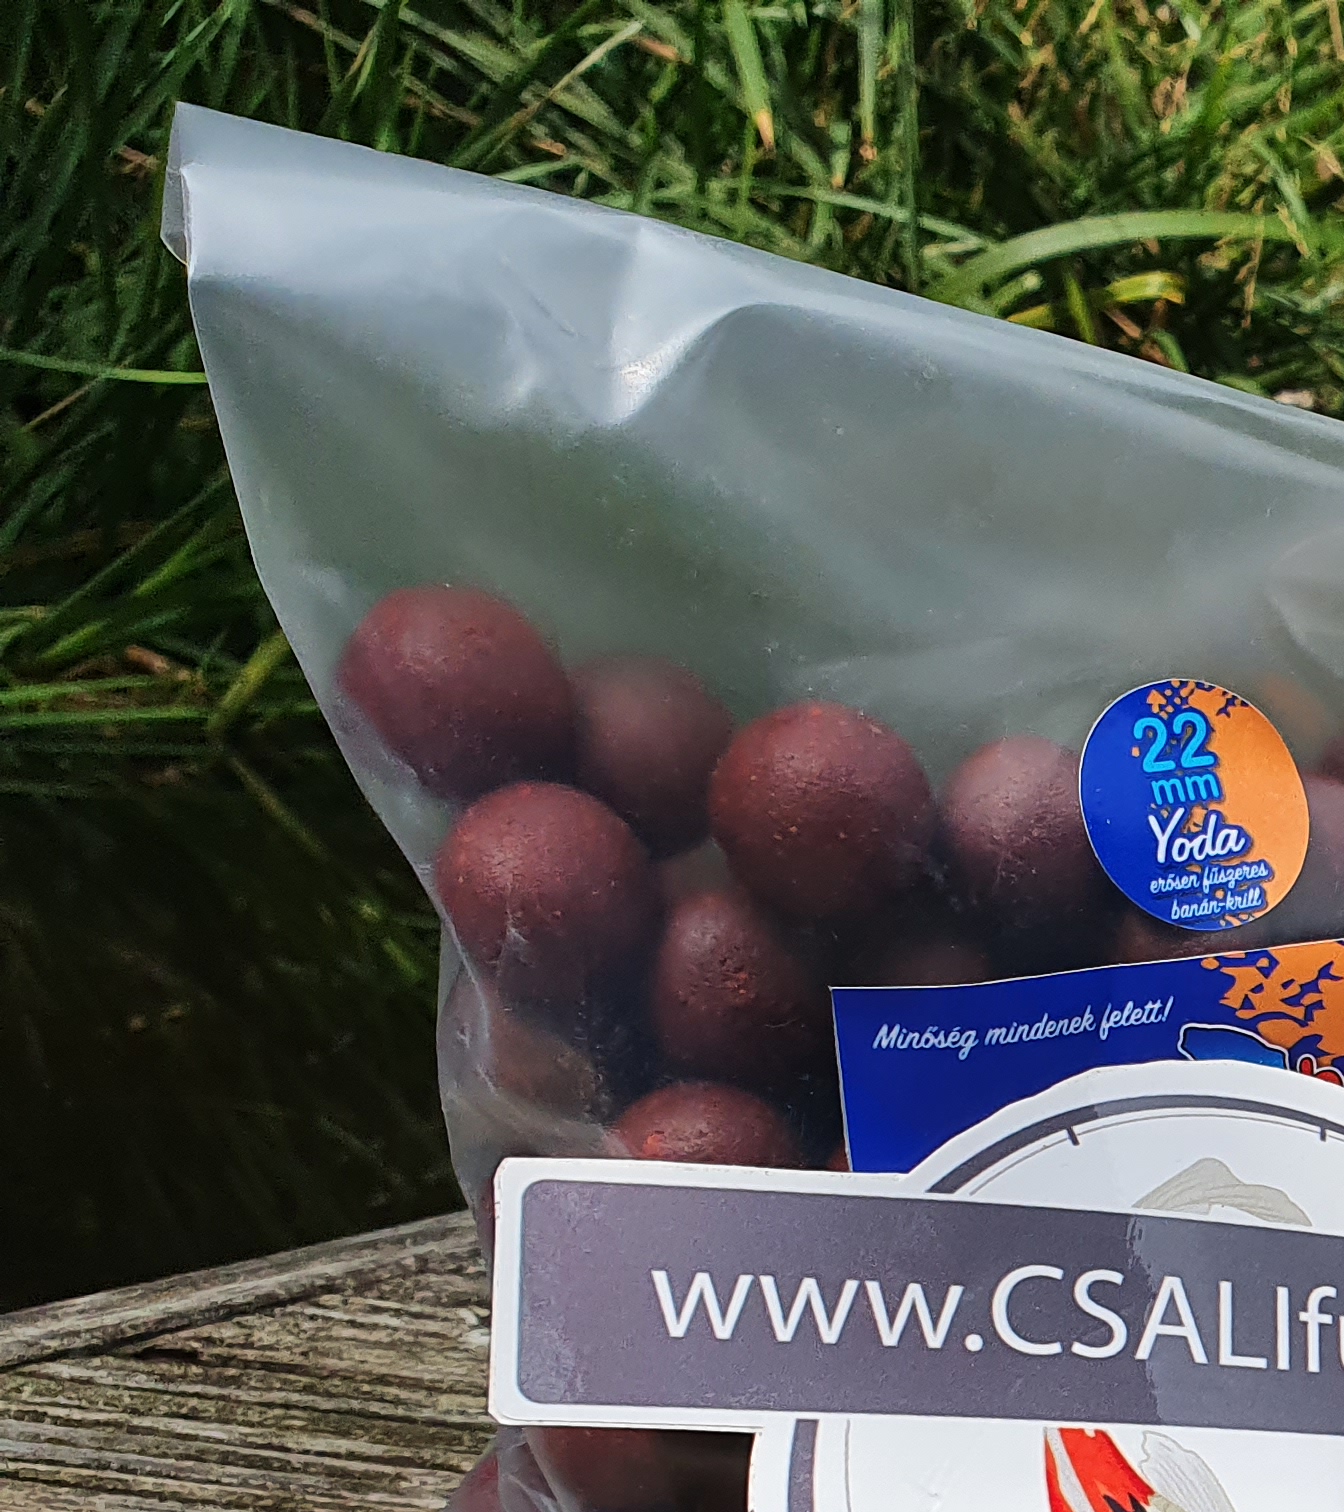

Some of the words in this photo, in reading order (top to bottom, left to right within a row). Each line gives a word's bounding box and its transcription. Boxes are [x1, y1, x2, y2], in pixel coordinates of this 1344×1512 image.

[1133, 711, 1216, 774] 22
[1151, 772, 1219, 806] mm
[1148, 807, 1247, 864] Yoda
[1150, 869, 1199, 894] erősen
[1202, 861, 1269, 893] fűszeres
[1171, 887, 1262, 920] banán-krill
[872, 1010, 977, 1060] Minőség
[984, 1005, 1096, 1045] mindenek
[1101, 996, 1174, 1041] felett!
